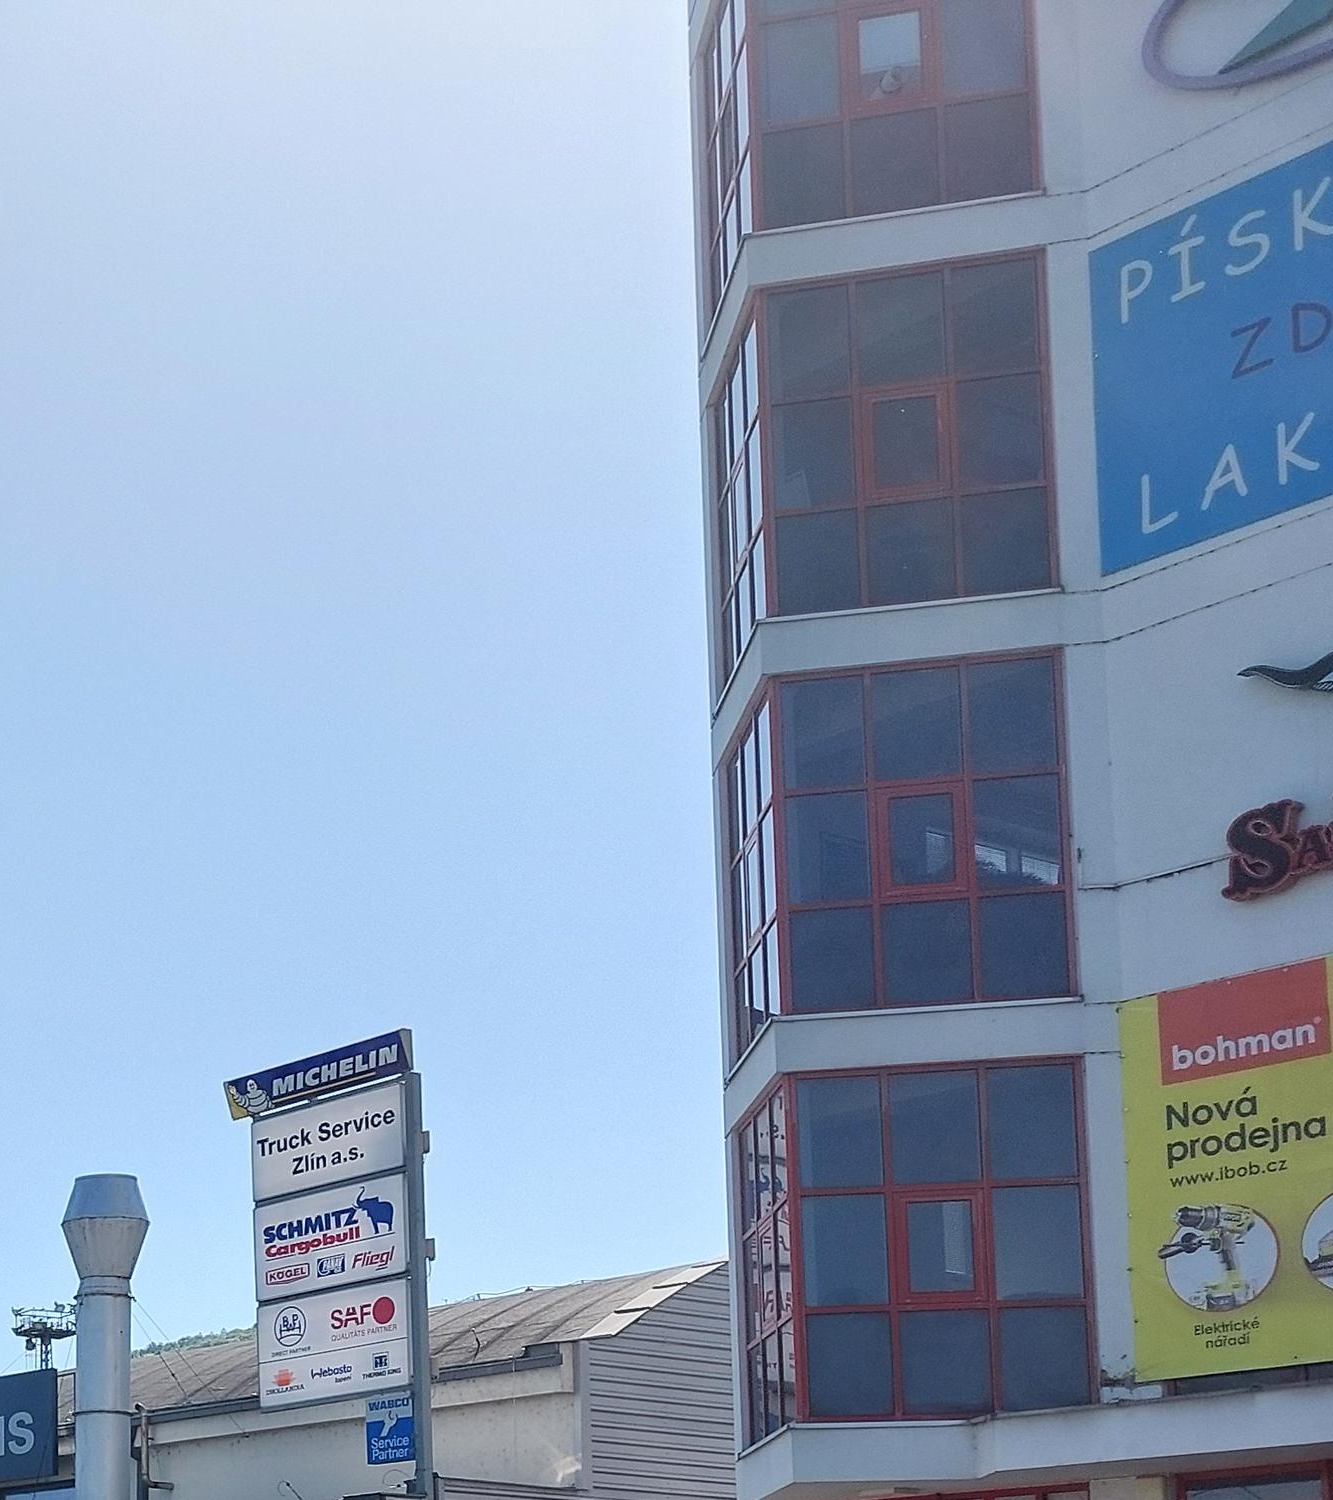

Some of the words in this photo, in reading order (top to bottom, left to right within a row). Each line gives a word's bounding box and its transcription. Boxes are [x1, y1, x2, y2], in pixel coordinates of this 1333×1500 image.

[1141, 411, 1321, 534] LAK
[1172, 1024, 1316, 1071] bohman
[271, 1043, 399, 1098] MICHELIN
[1165, 1086, 1258, 1131] Nová
[257, 1128, 312, 1157] Truck
[318, 1109, 396, 1142] Service
[1166, 1116, 1327, 1169] prodejna
[291, 1154, 327, 1175] Zlín
[331, 1146, 365, 1166] a.s.
[1170, 1159, 1288, 1188] www.ibob.cz
[263, 1207, 359, 1245] SCHMITZ
[265, 1226, 361, 1258] Cargobull
[352, 1246, 395, 1269] Fliegl
[330, 1303, 372, 1330] SAF
[1194, 1316, 1260, 1336] Elektrické
[310, 1363, 353, 1380] Webasto
[368, 1398, 409, 1412] WABCO
[371, 1435, 410, 1450] Service
[372, 1448, 409, 1461] Partner
